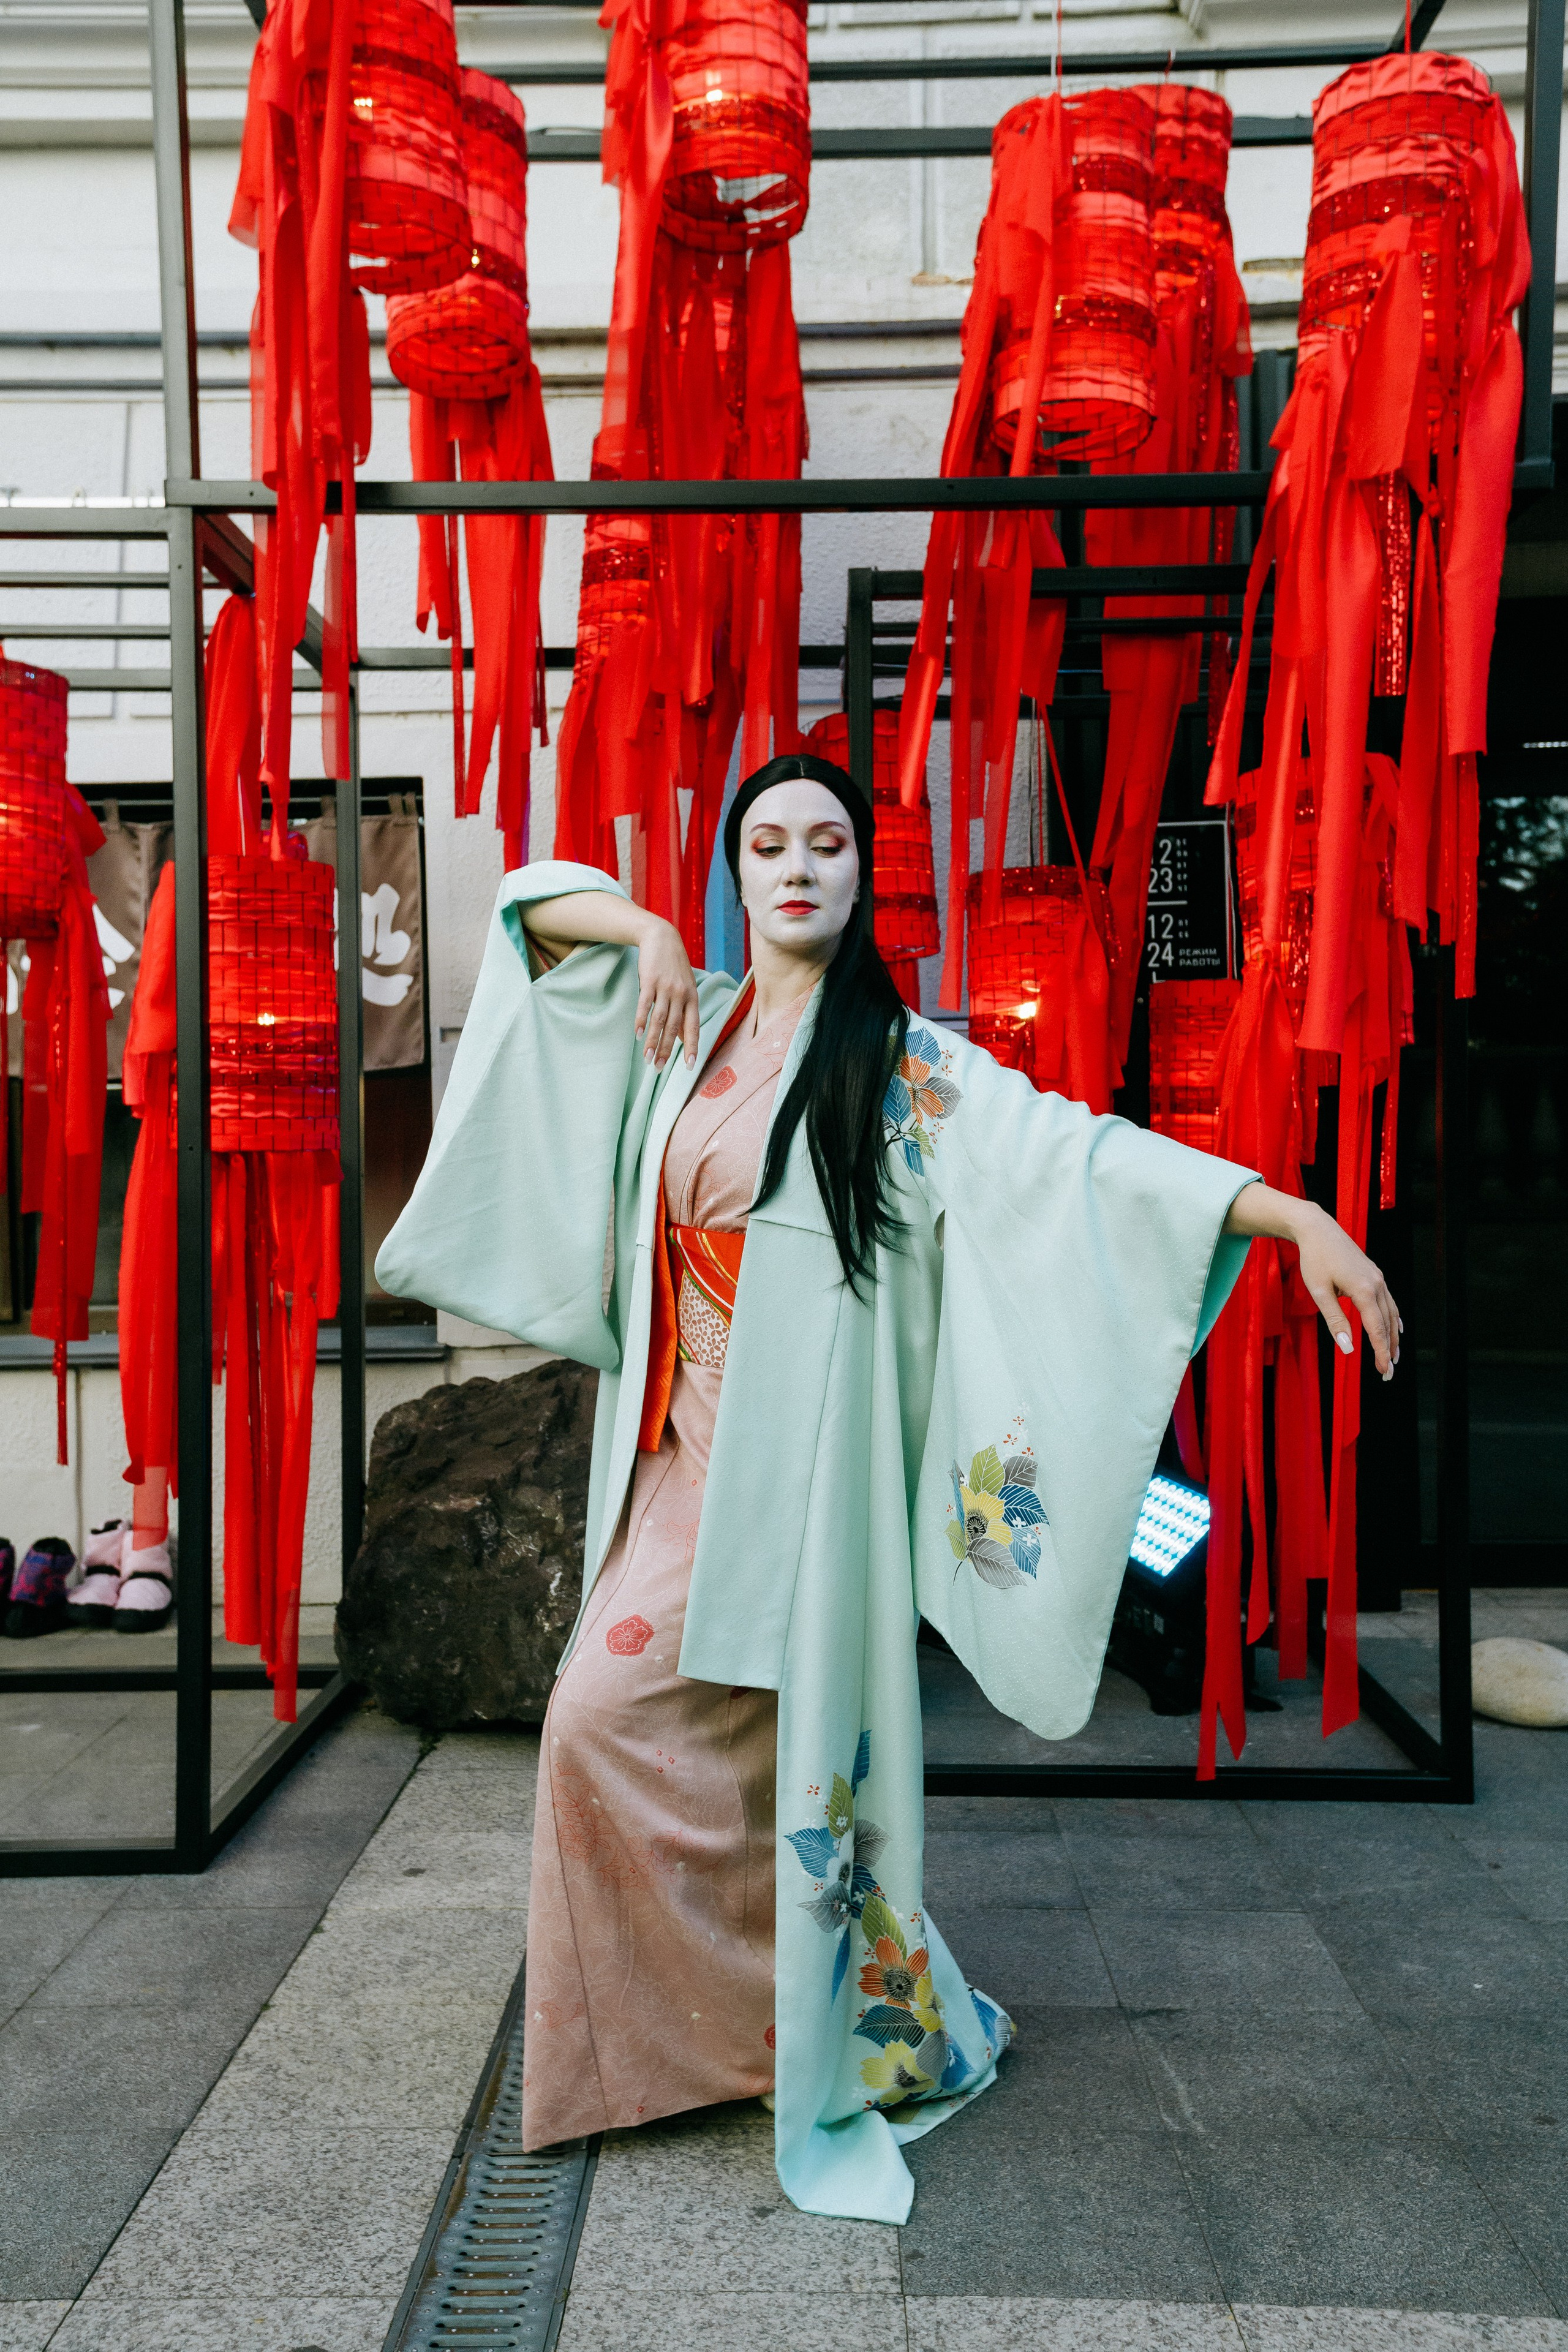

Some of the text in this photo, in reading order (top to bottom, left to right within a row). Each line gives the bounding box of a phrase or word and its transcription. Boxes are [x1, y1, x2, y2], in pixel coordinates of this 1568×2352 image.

[1151, 839, 1172, 865] 2
[1148, 867, 1173, 893] 23
[1147, 913, 1174, 939] 12
[1147, 941, 1174, 967] 24
[1179, 948, 1217, 957] РЕЖИМ
[1179, 958, 1221, 967] РАБОТЫ
